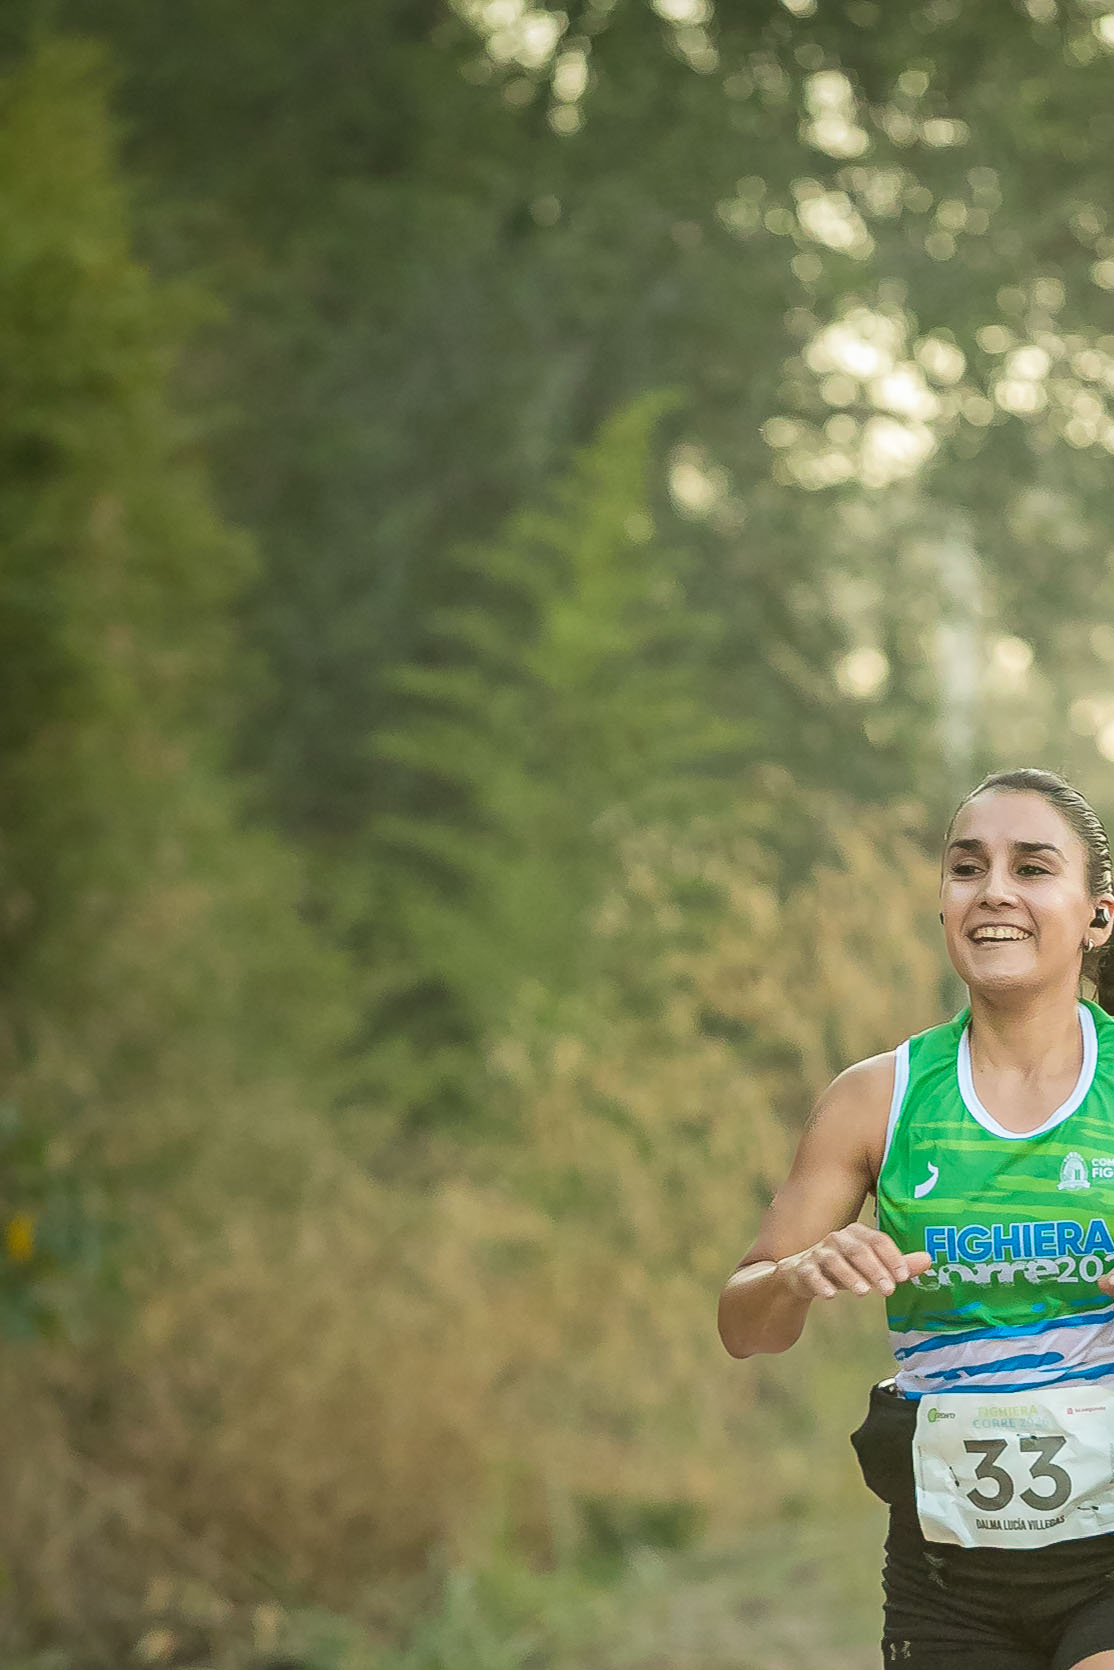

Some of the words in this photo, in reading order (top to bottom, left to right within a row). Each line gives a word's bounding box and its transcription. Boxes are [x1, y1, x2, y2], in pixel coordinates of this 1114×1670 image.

[973, 1418, 1016, 1429] CORRE
[963, 1436, 1072, 1511] 33
[976, 1519, 1001, 1530] DALMA
[1004, 1517, 1026, 1530] LUCÍA
[1026, 1515, 1065, 1530] VILLEGAS
